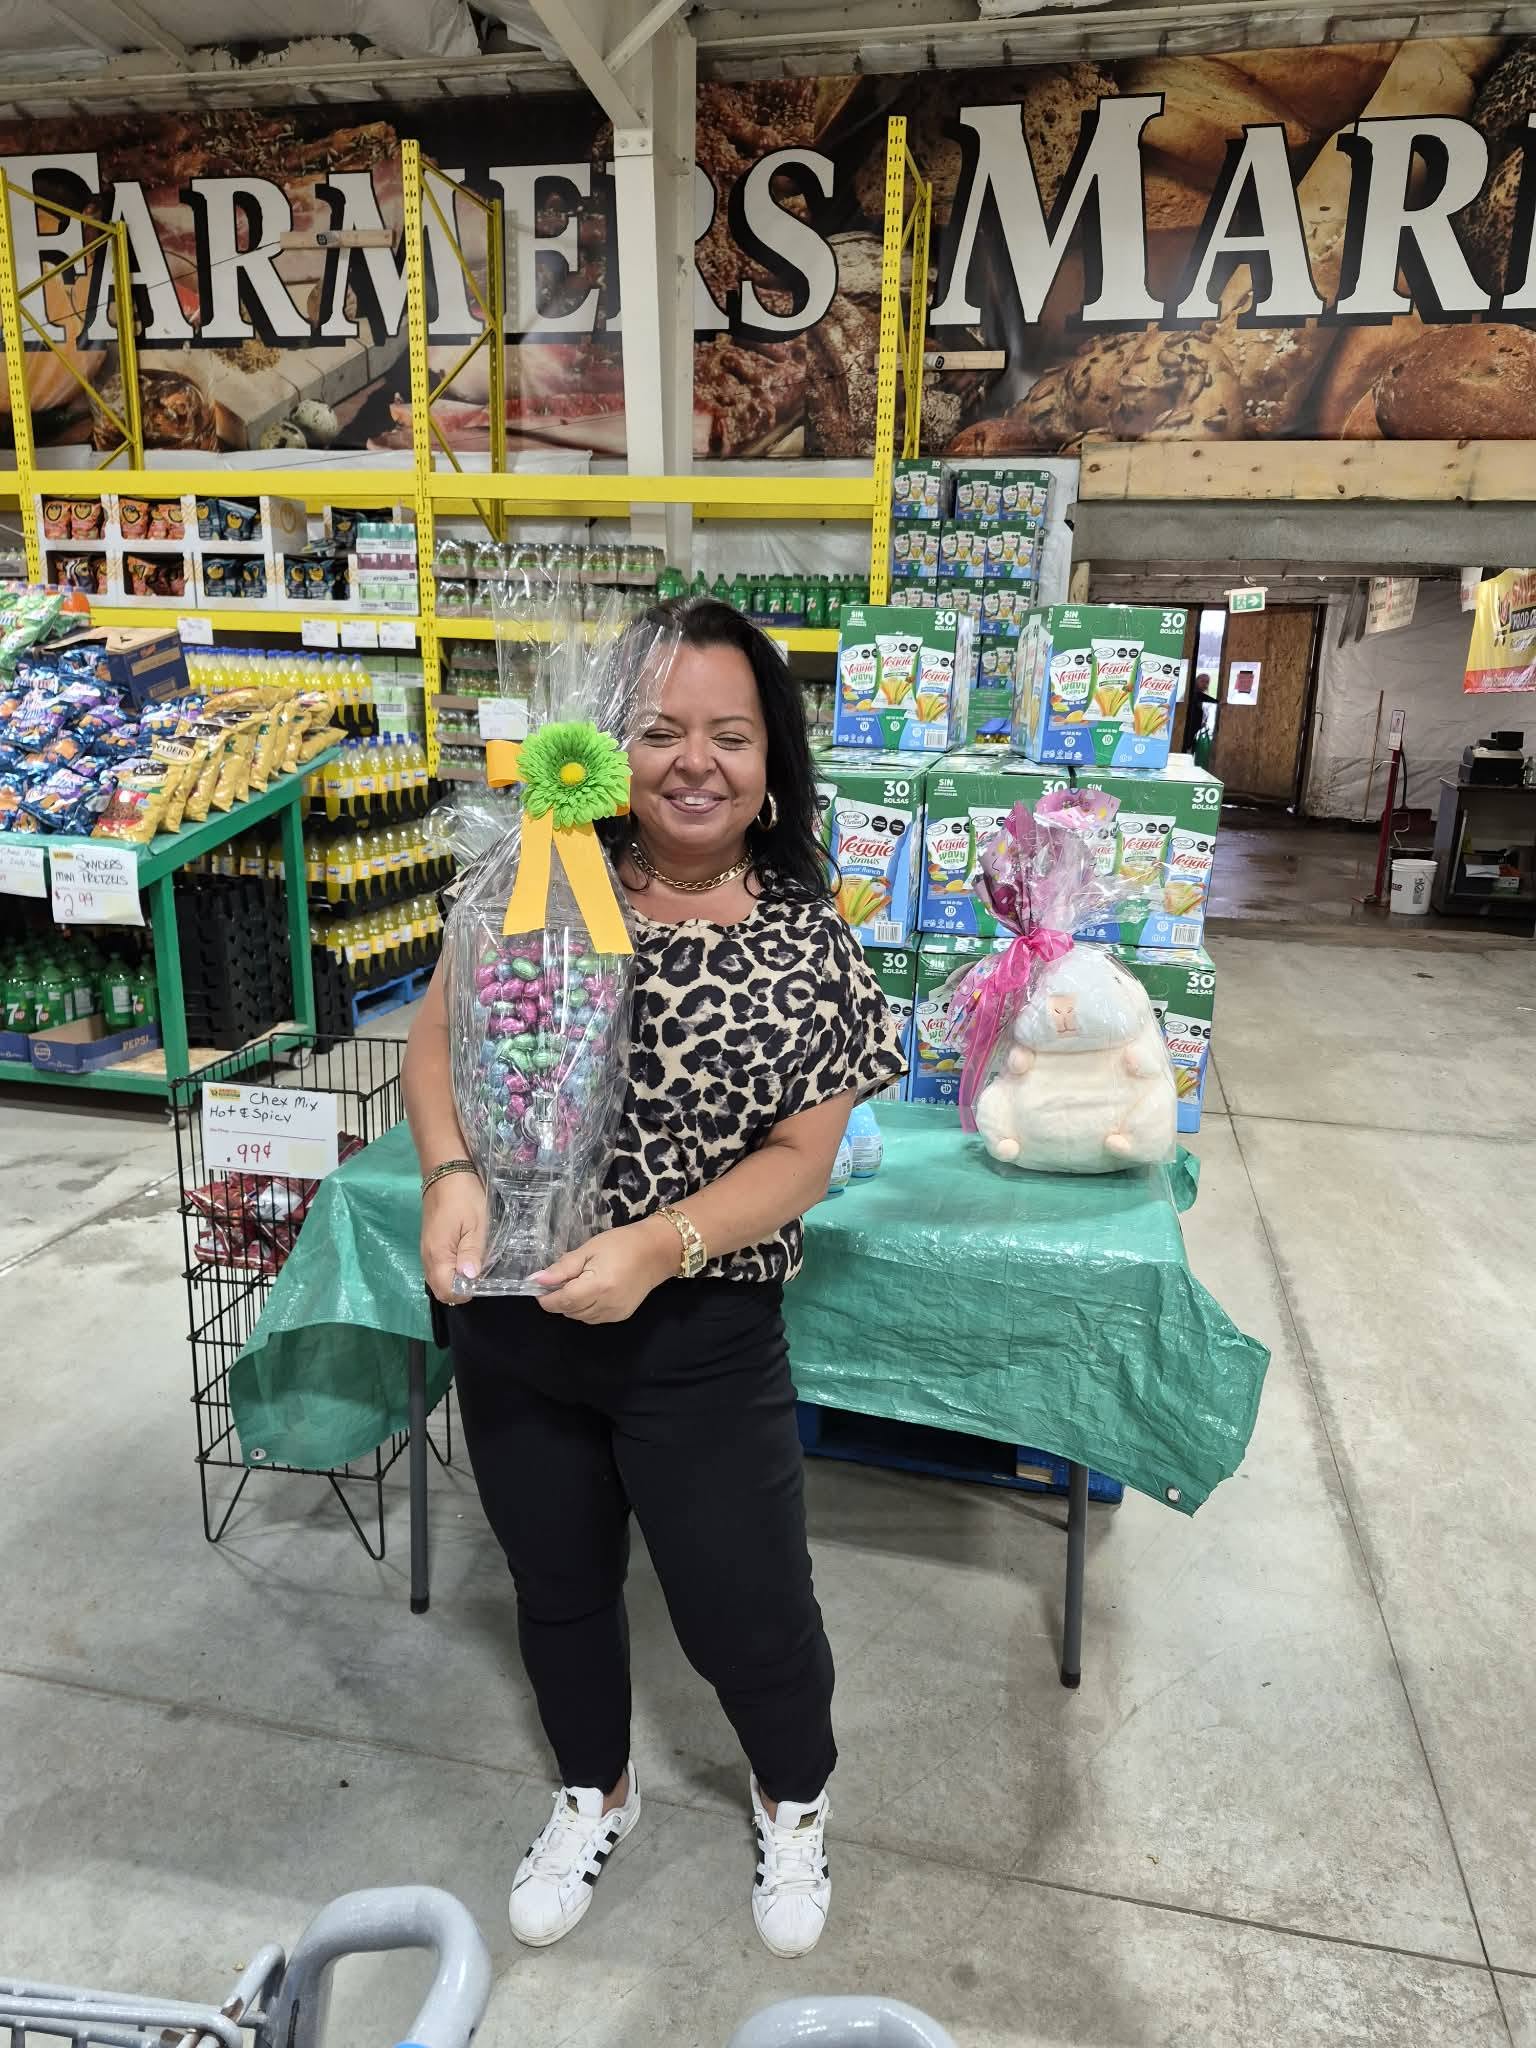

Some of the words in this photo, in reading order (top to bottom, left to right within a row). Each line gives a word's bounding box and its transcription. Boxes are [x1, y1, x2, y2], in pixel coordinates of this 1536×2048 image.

[931, 94, 1536, 324] MAR
[935, 611, 956, 626] 30
[1160, 613, 1186, 628] 30
[1055, 668, 1090, 684] Veggie
[1096, 662, 1132, 676] Veggie
[1139, 676, 1175, 692] Veggie
[884, 781, 910, 796] 30
[939, 778, 954, 786] SIN
[1192, 788, 1220, 804] 30
[838, 833, 895, 857] Veggie
[932, 838, 968, 854] Veggie
[1122, 837, 1164, 851] Veggie
[848, 856, 880, 865] Straws
[939, 851, 966, 862] wavy
[1172, 853, 1212, 870] Veggie
[882, 952, 908, 968] 30
[1187, 972, 1215, 988] 30
[1166, 1037, 1204, 1054] Veggie
[250, 1092, 288, 1106] Chex
[294, 1096, 318, 1112] Mix
[210, 1105, 236, 1118] Hot
